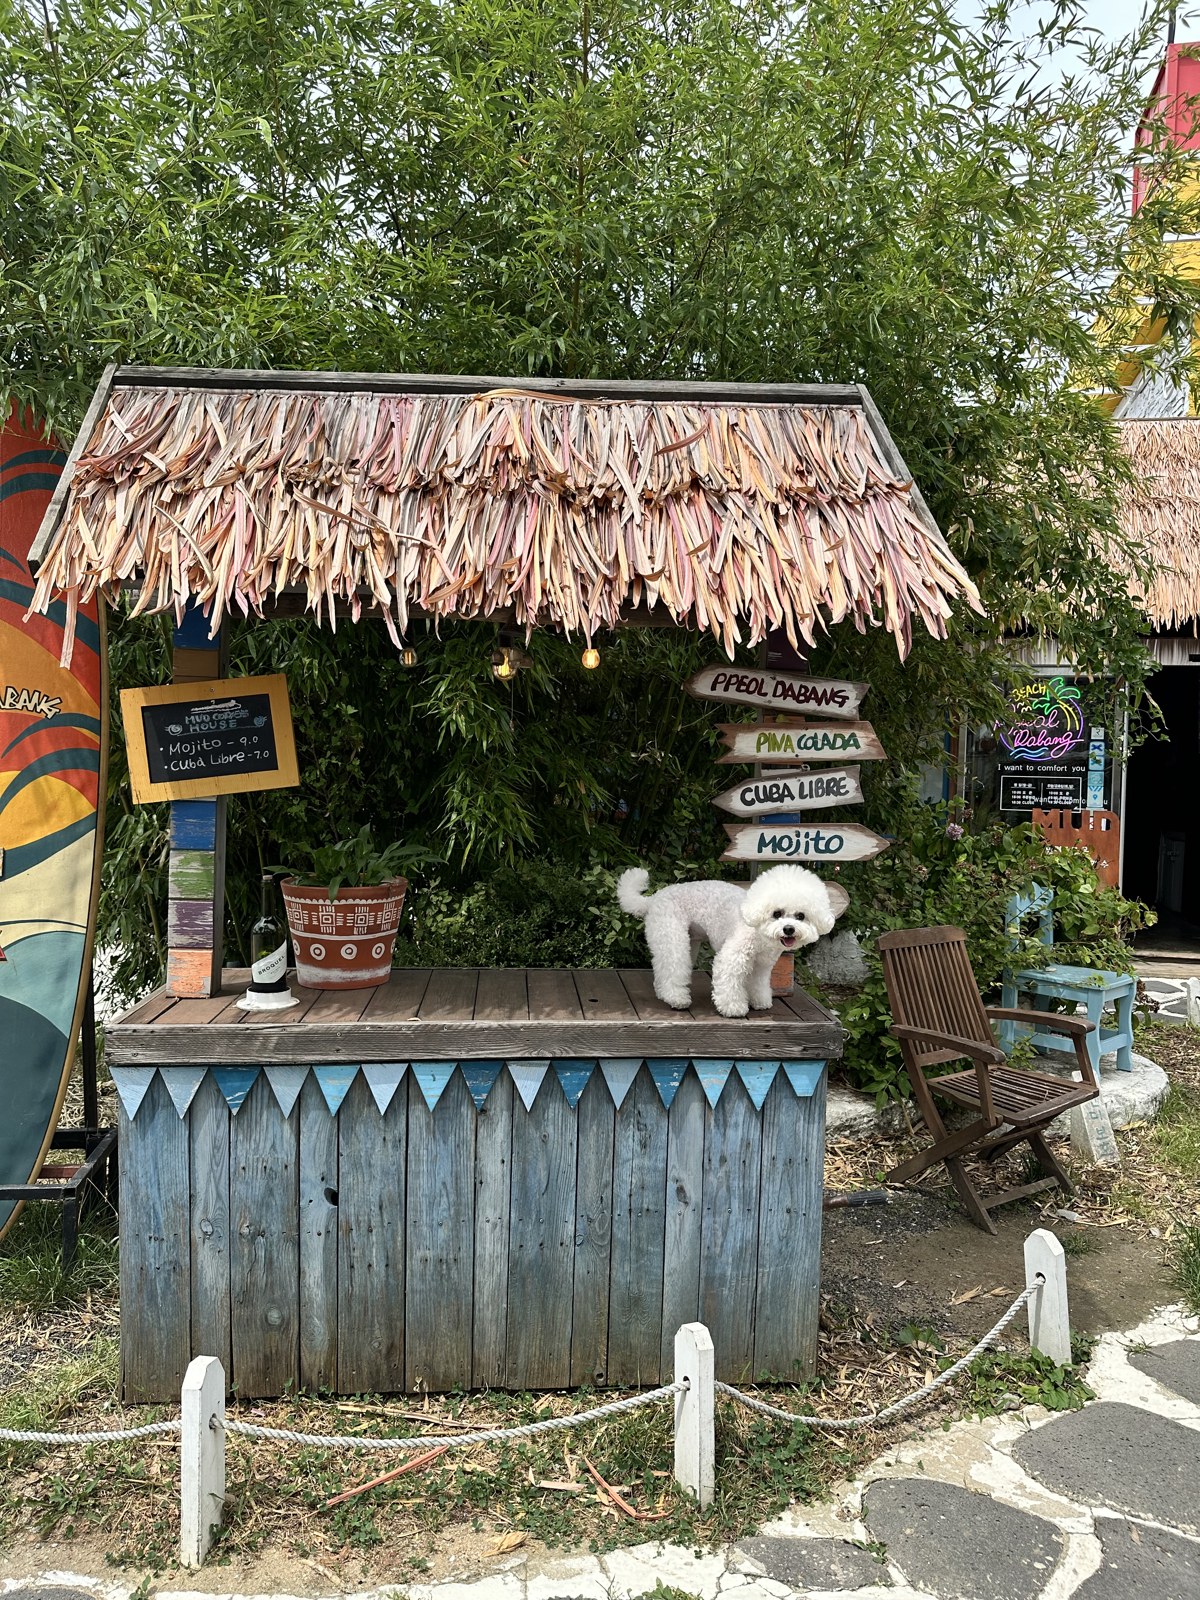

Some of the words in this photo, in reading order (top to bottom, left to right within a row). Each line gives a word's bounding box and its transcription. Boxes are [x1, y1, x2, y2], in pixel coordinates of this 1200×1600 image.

[710, 673, 769, 697] PPEOL
[772, 680, 850, 707] DABANG
[185, 714, 210, 725] MUD
[189, 719, 237, 733] HOUSE
[169, 738, 222, 756] Mojito
[239, 735, 259, 747] 9.0
[1014, 729, 1085, 759] Dabang
[210, 751, 245, 765] Libre
[254, 750, 270, 759] 7.0
[1037, 764, 1067, 772] comfort
[740, 783, 795, 807] CUBA
[798, 776, 851, 799] LIBRE
[1032, 808, 1119, 832] MUD
